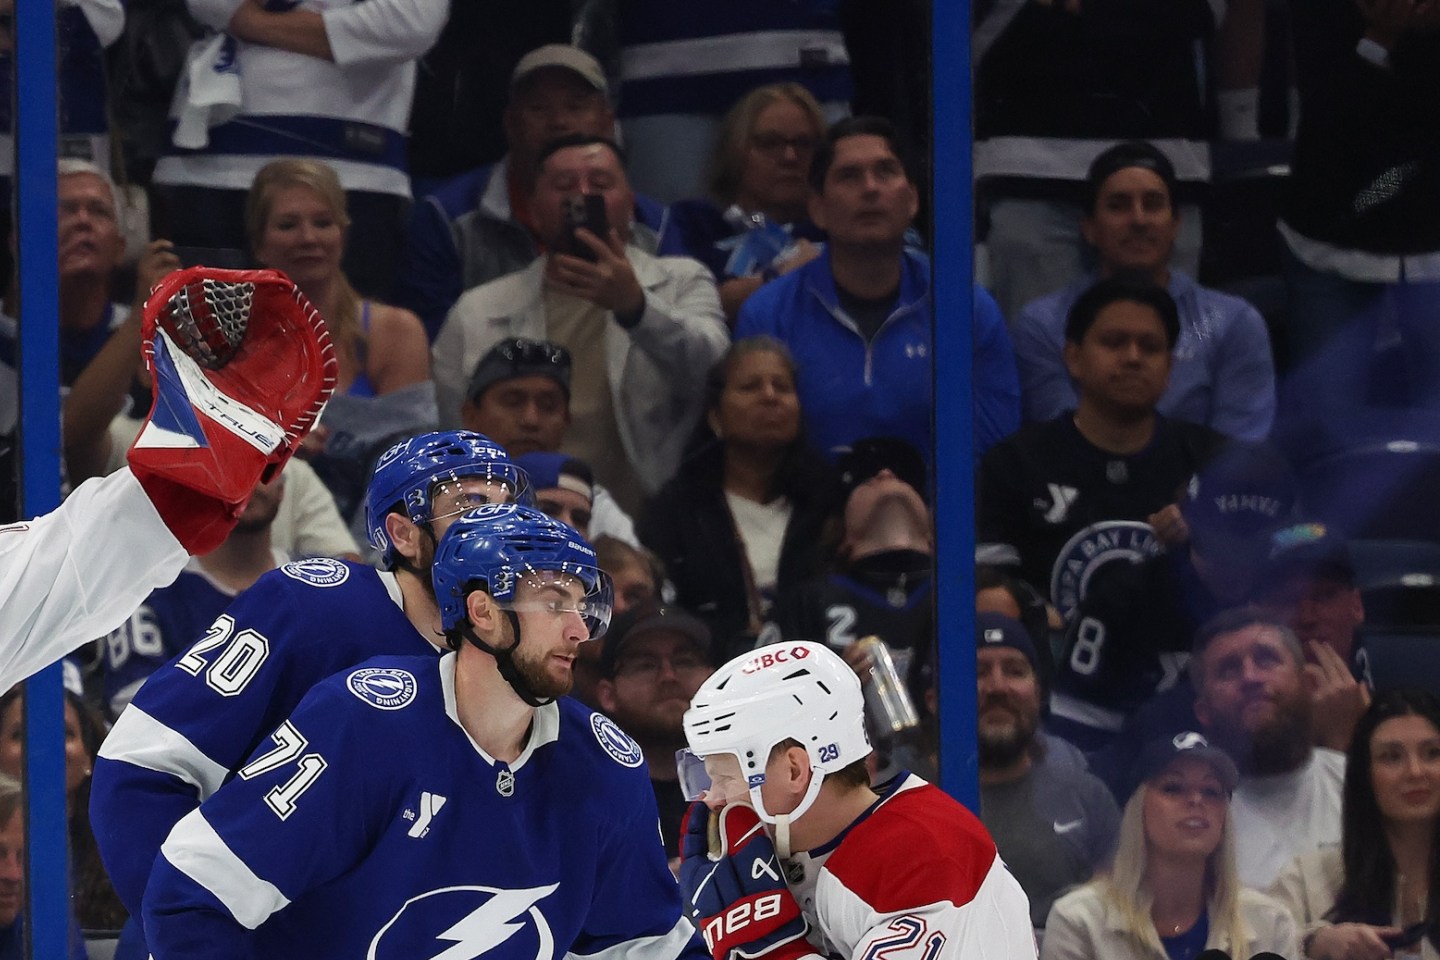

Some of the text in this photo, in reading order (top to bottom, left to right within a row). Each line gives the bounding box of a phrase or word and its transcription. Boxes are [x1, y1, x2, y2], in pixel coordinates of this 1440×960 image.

[207, 401, 275, 449] TRUE
[173, 613, 271, 698] 20
[742, 650, 789, 676] CIBC
[1070, 616, 1106, 676] 8
[375, 679, 413, 706] LIGHTNING
[237, 718, 329, 822] 71
[402, 808, 415, 821] the
